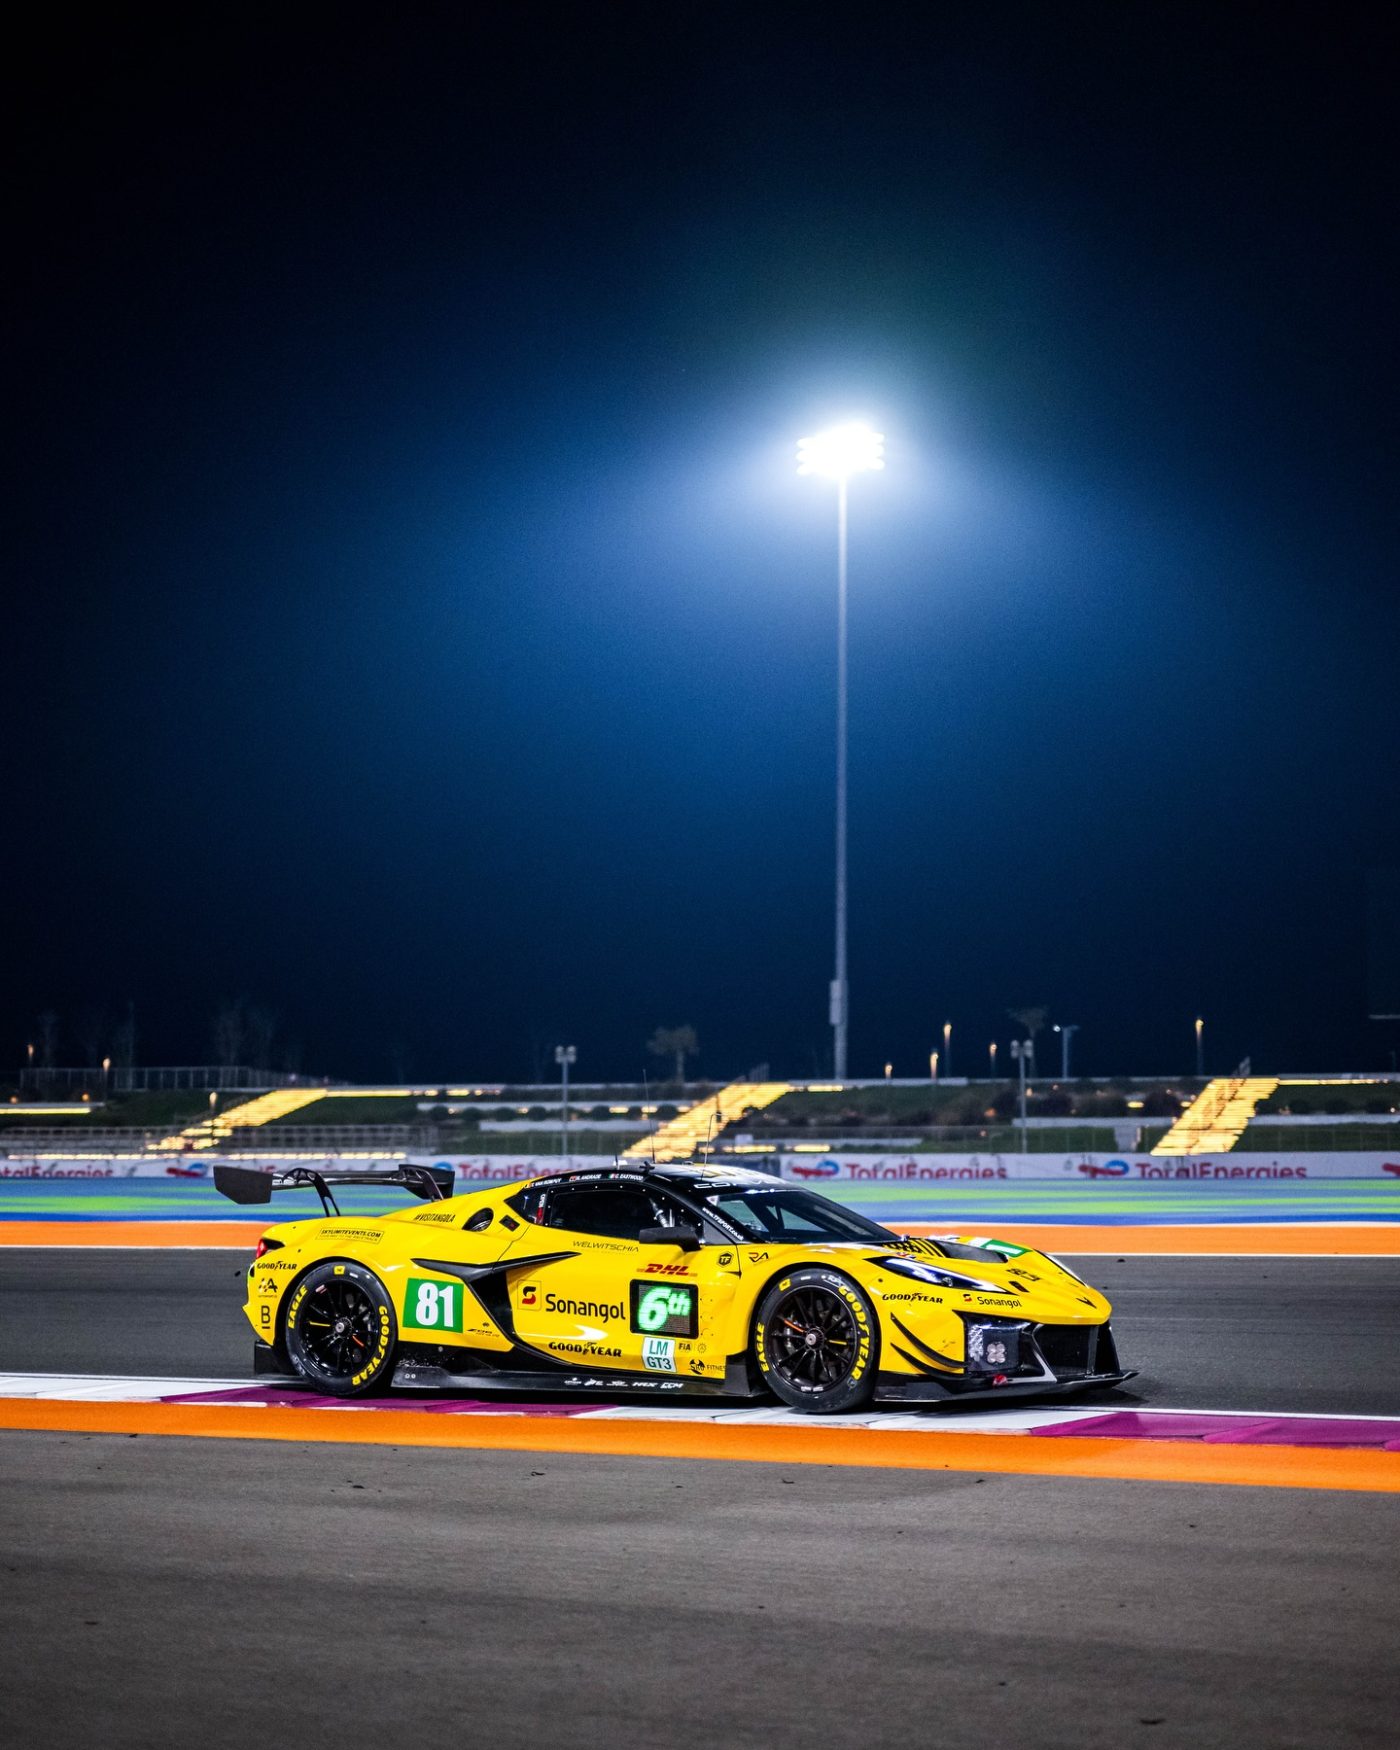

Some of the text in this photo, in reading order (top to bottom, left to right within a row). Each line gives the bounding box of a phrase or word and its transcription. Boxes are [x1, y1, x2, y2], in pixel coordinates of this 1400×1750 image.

[846, 1162, 1007, 1179] TotalEnergies
[1136, 1162, 1308, 1178] TotalEnergies
[572, 1240, 639, 1252] WELWITSCHIA
[257, 1261, 298, 1270] GOODYEAR
[645, 1264, 689, 1276] DHL
[415, 1282, 454, 1328] 81
[882, 1292, 943, 1304] GOODYEAR
[977, 1296, 1022, 1309] Sonangol
[287, 1284, 308, 1329] EAGLE
[545, 1293, 626, 1323] Sonangol
[637, 1286, 692, 1331] 6th
[838, 1285, 870, 1380] GOODYEAR
[352, 1305, 390, 1385] GOODYEAR
[548, 1341, 622, 1357] GOODYEAR
[649, 1340, 669, 1356] LM
[678, 1343, 691, 1351] FIA
[756, 1322, 770, 1372] EAGLE
[646, 1356, 672, 1370] GT3
